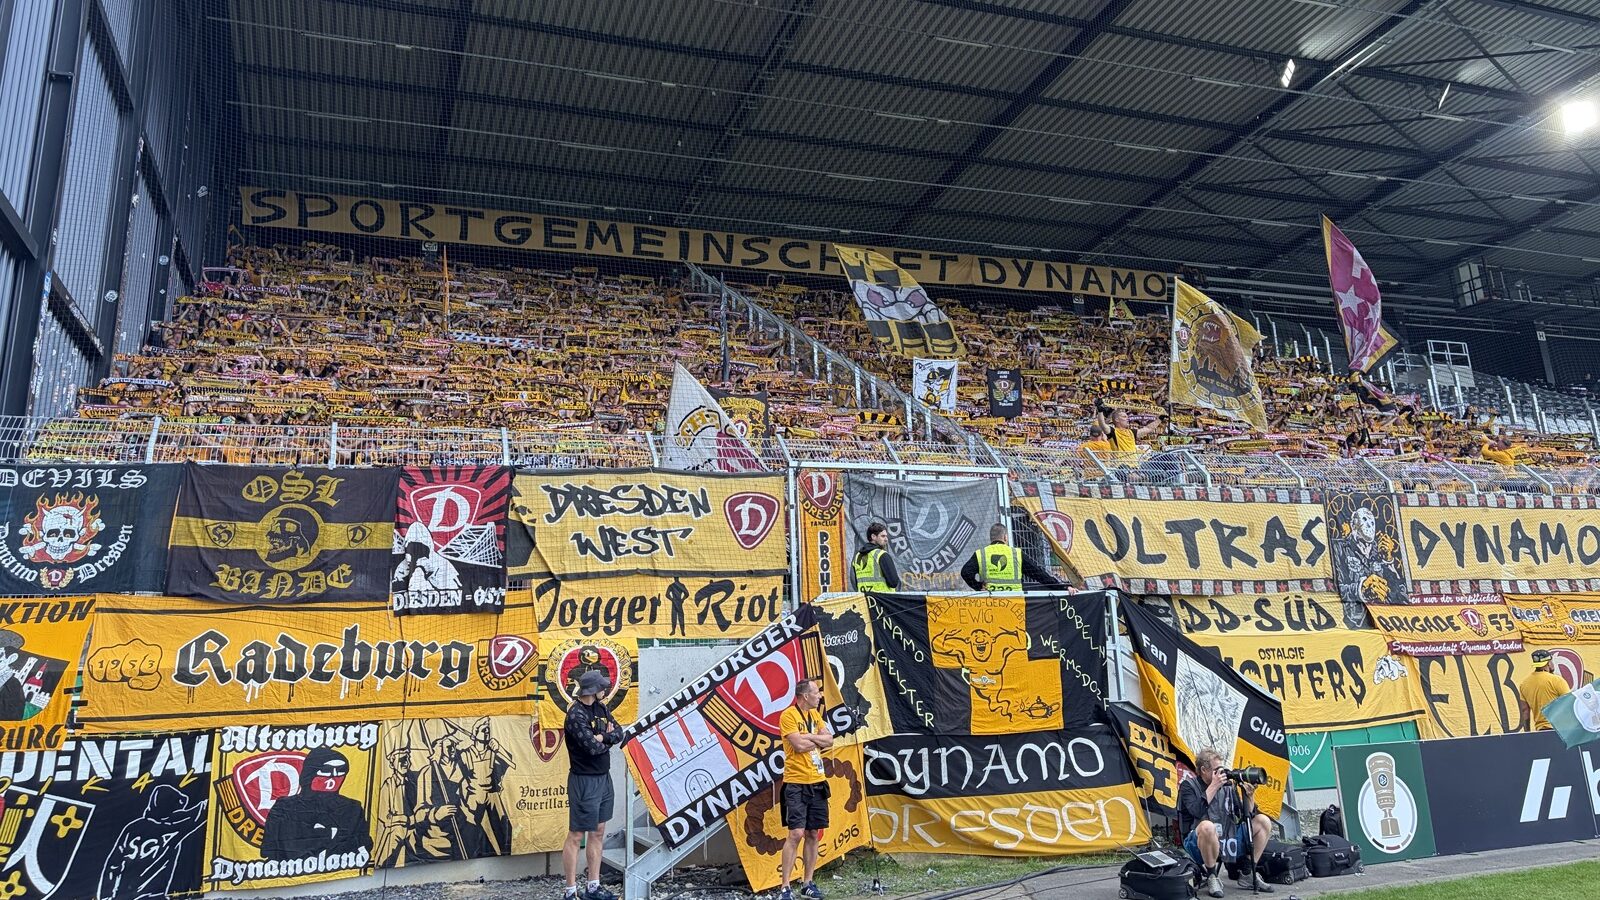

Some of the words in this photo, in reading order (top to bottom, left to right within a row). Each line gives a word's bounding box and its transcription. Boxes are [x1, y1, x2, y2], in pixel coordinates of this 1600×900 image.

[250, 190, 958, 282] SPORTGEMEINSCHFT
[980, 256, 1167, 297] DYNAMO
[0, 468, 147, 489] DEVILS
[242, 470, 345, 507] OSL
[540, 484, 712, 524] DRESDEN
[803, 493, 844, 520] DRESDEN
[74, 524, 134, 584] Dresden
[569, 525, 695, 564] WEST
[887, 522, 958, 575] DRESDEN
[1085, 512, 1326, 569] ULTRAS
[1410, 518, 1600, 569] DYNAMO
[208, 563, 354, 599] BANDE
[535, 577, 661, 636] Jogger
[694, 577, 780, 633] Riot
[959, 607, 994, 625] EWIG
[1178, 595, 1338, 633] DD-SÜD
[1376, 614, 1462, 634] BRIGADE
[1487, 613, 1516, 632] 53
[1510, 606, 1541, 622] EAST
[867, 595, 924, 663] DYNAMO
[98, 659, 156, 670] 1953
[171, 623, 475, 690] Radeburg
[1140, 633, 1169, 666] Fan
[1258, 646, 1305, 660] OSTALGIE
[478, 655, 525, 690] DRESDEN
[735, 650, 796, 720] D
[876, 648, 935, 728] GEISTER
[220, 722, 380, 753] Altenburg
[1250, 715, 1285, 746] Club
[1129, 745, 1179, 809] 53
[515, 797, 570, 811] Guerillas
[665, 750, 785, 846] DYNAMO
[833, 823, 861, 852] 1996
[211, 845, 370, 885] Dynamoland
